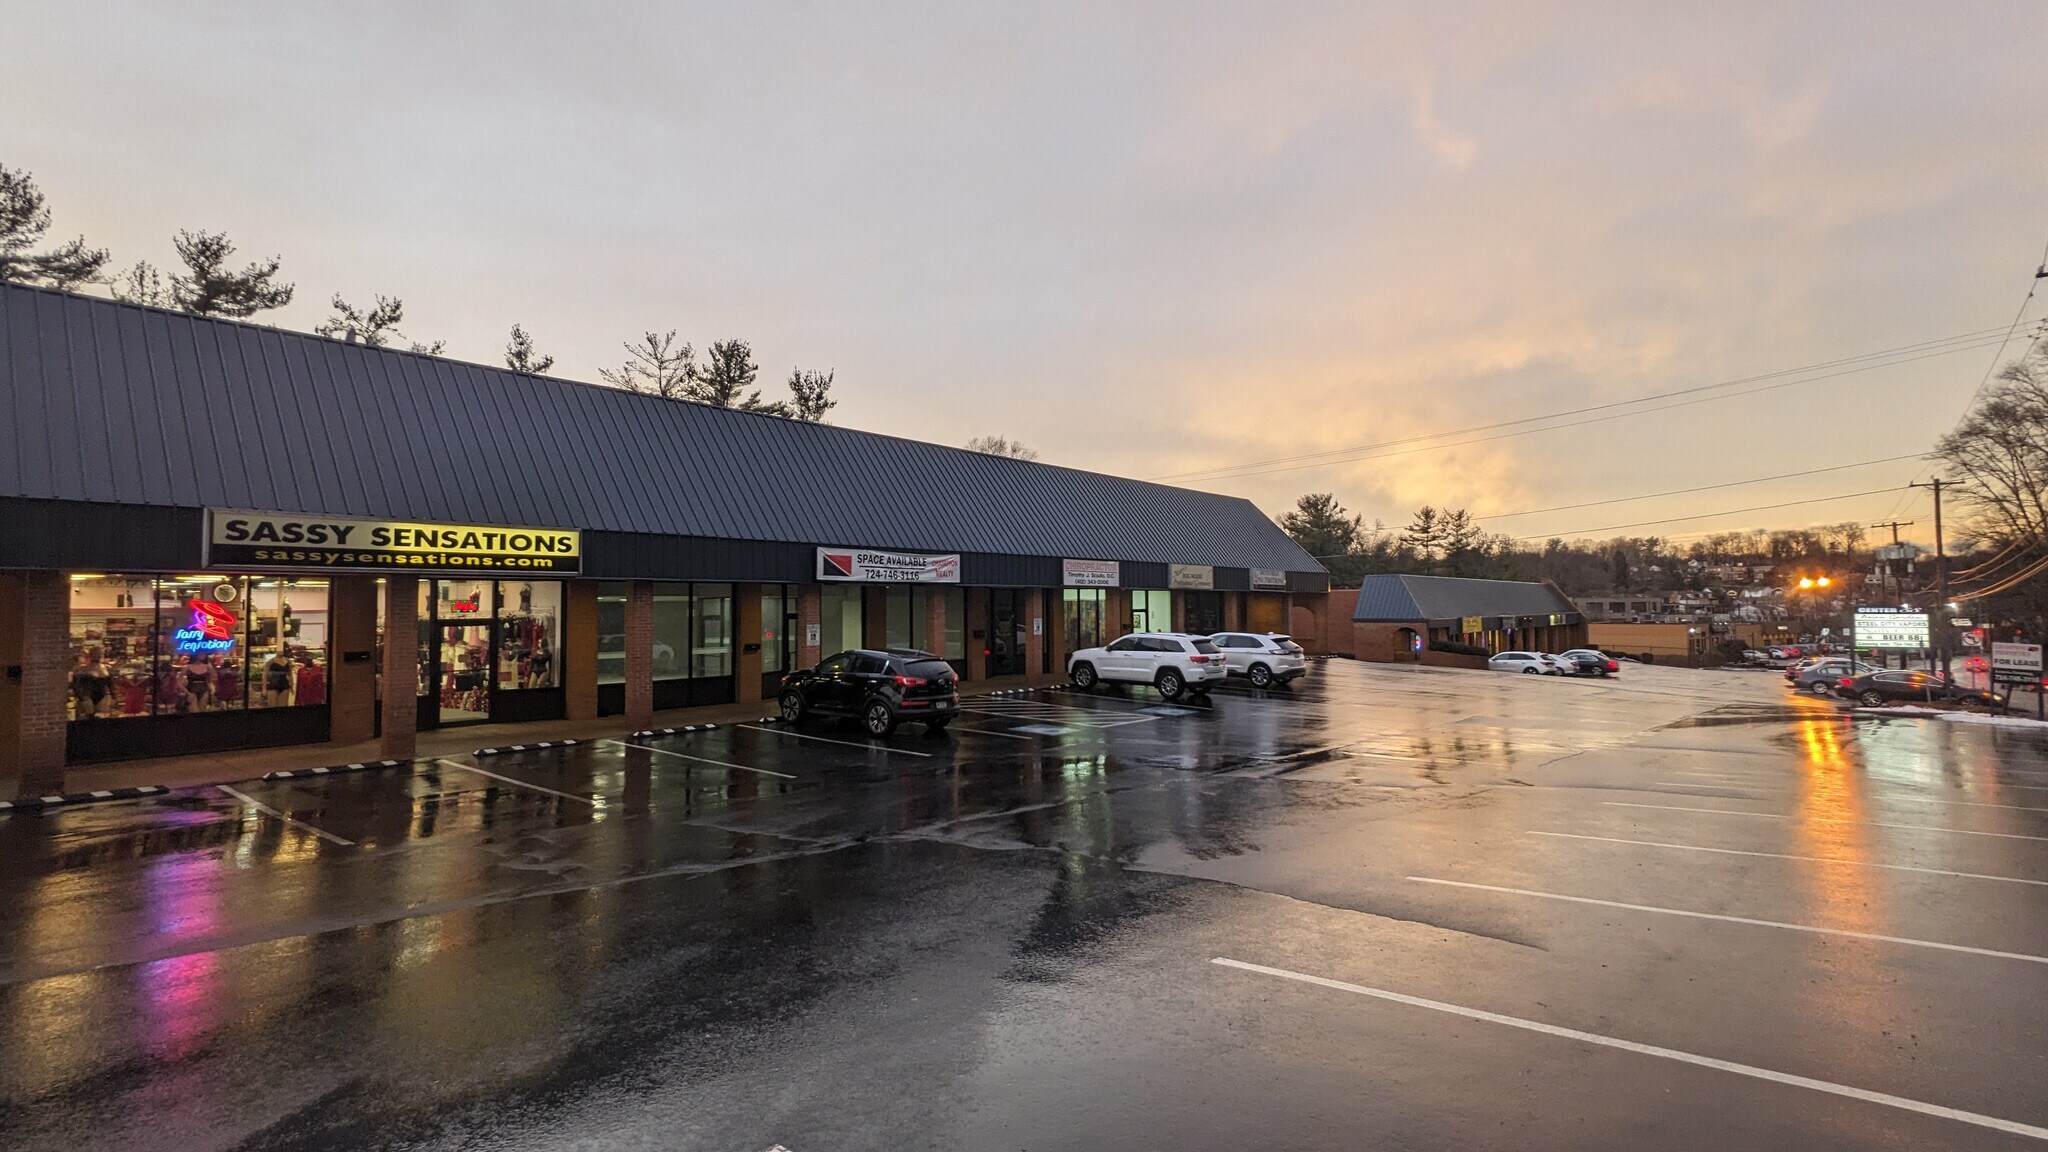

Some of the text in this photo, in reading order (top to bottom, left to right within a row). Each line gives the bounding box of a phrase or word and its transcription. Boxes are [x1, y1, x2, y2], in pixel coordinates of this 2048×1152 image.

[225, 519, 573, 553] SASSY SENSATIONS
[255, 549, 553, 567] sassysensations.com
[857, 554, 927, 567] SPACE AVAILABLE
[865, 569, 920, 581] 724-746-3116
[1994, 658, 2039, 667] FOR LEASE
